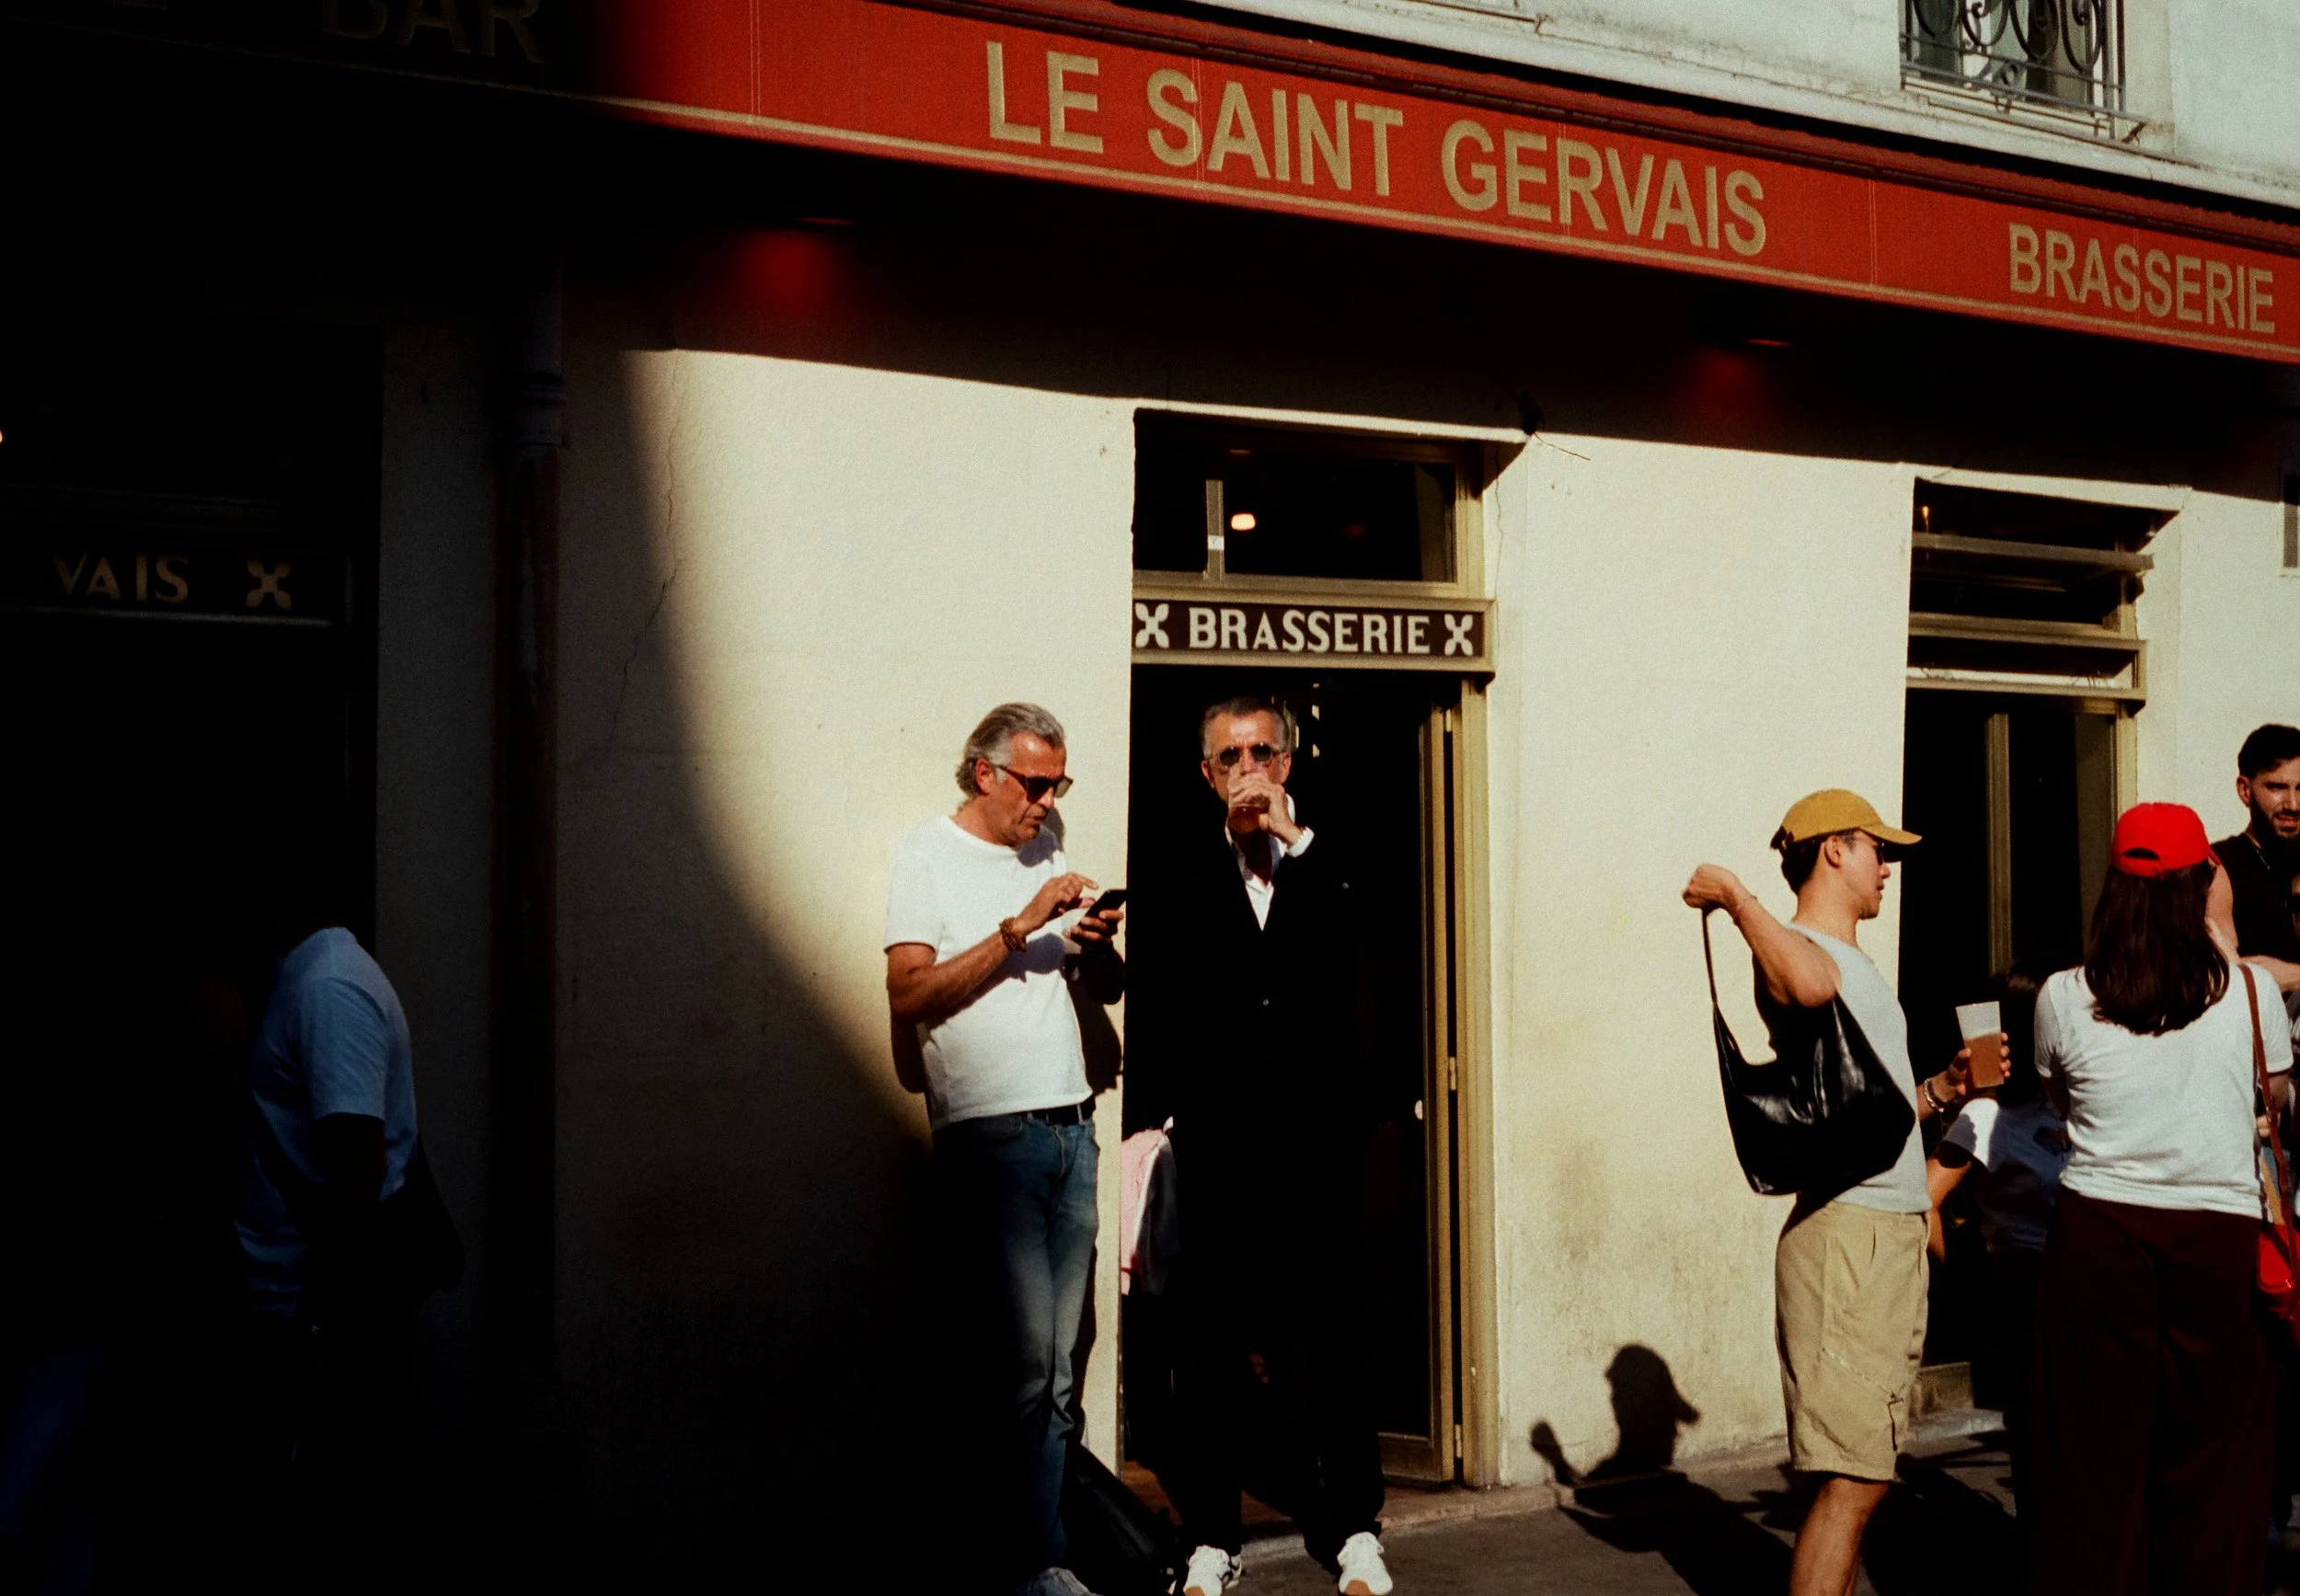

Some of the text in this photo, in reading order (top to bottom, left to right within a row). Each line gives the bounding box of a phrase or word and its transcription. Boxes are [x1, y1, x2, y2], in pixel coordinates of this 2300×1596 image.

[986, 40, 1766, 257] LE SAINT GERVAIS
[2008, 222, 2276, 335] BRASSERIE
[1189, 607, 1431, 655] BRASSERIE
